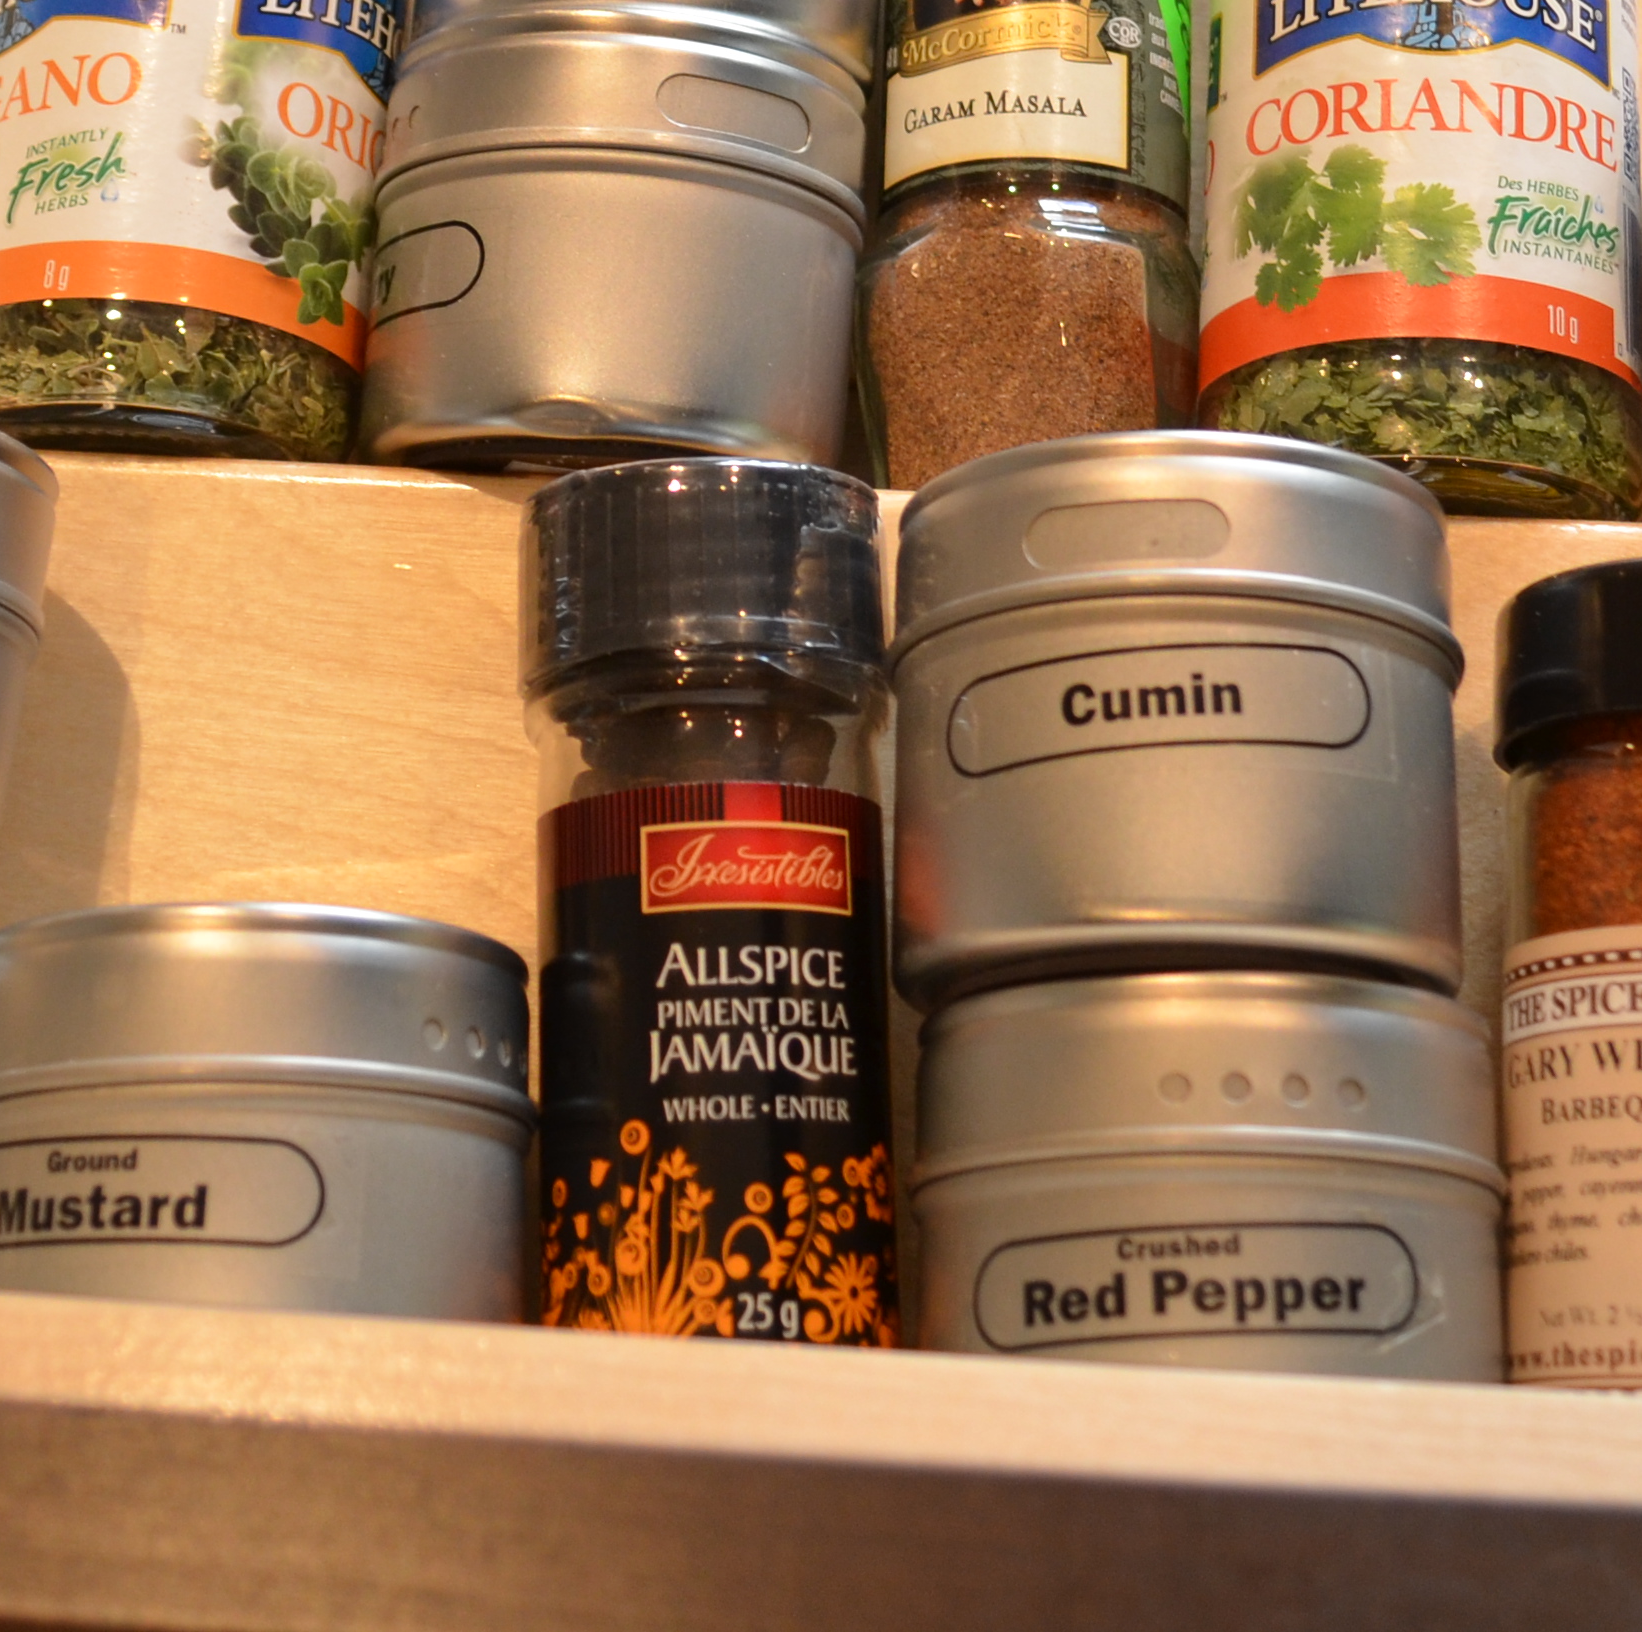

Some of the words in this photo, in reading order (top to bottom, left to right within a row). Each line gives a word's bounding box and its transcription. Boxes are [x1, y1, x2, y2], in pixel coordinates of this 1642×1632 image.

[902, 13, 1076, 68] McCormick
[904, 97, 976, 135] GARAM
[984, 88, 1088, 119] MASALA
[1245, 77, 1619, 173] CORIANDRE
[26, 127, 109, 160] INSTANTLY
[7, 131, 126, 225] Fresh
[1497, 174, 1524, 191] Des
[1526, 179, 1580, 203] HERBES
[34, 192, 89, 216] HERBS
[1488, 194, 1620, 258] Fraîches
[1546, 303, 1566, 338] 10
[1061, 674, 1243, 727] Cumin
[649, 832, 845, 898] Irresistibles
[656, 943, 846, 990] ALLSPICE
[658, 998, 771, 1030] PIMENT
[778, 1000, 817, 1028] DE
[821, 1002, 849, 1030] LA
[1508, 992, 1545, 1032] THE
[649, 1025, 858, 1084] JAMAÏQUE
[662, 1095, 757, 1123] WHOLE
[776, 1096, 850, 1124] ENTIER
[47, 1148, 139, 1173] Ground
[1117, 1232, 1242, 1261] Crushed
[737, 1292, 774, 1331] 25
[780, 1299, 801, 1339] g
[1022, 1273, 1128, 1328] Red
[1151, 1269, 1367, 1324] Pepper
